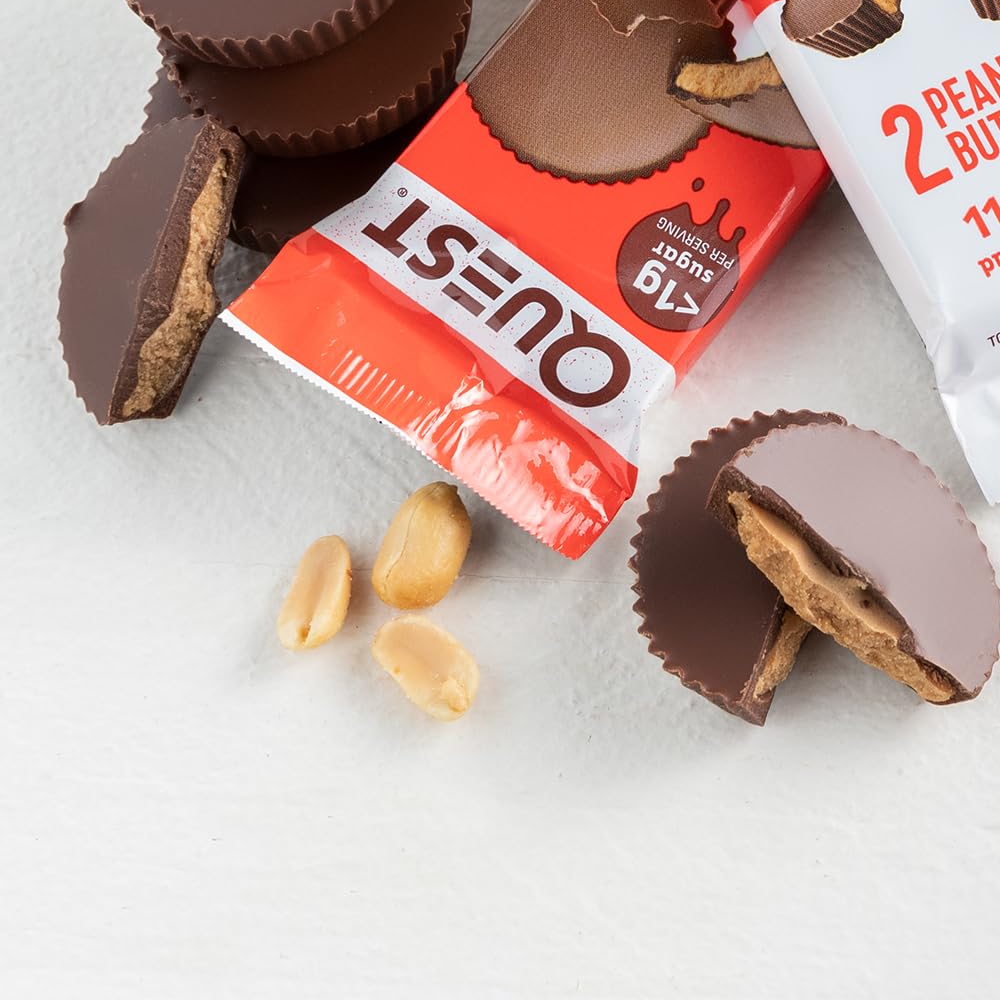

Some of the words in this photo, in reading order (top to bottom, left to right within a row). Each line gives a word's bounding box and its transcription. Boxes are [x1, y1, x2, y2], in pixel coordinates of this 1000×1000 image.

[881, 103, 953, 195] 2
[656, 216, 710, 255] SERVING
[651, 241, 715, 283] sugar
[709, 247, 735, 270] PER
[361, 198, 632, 408] QUEST
